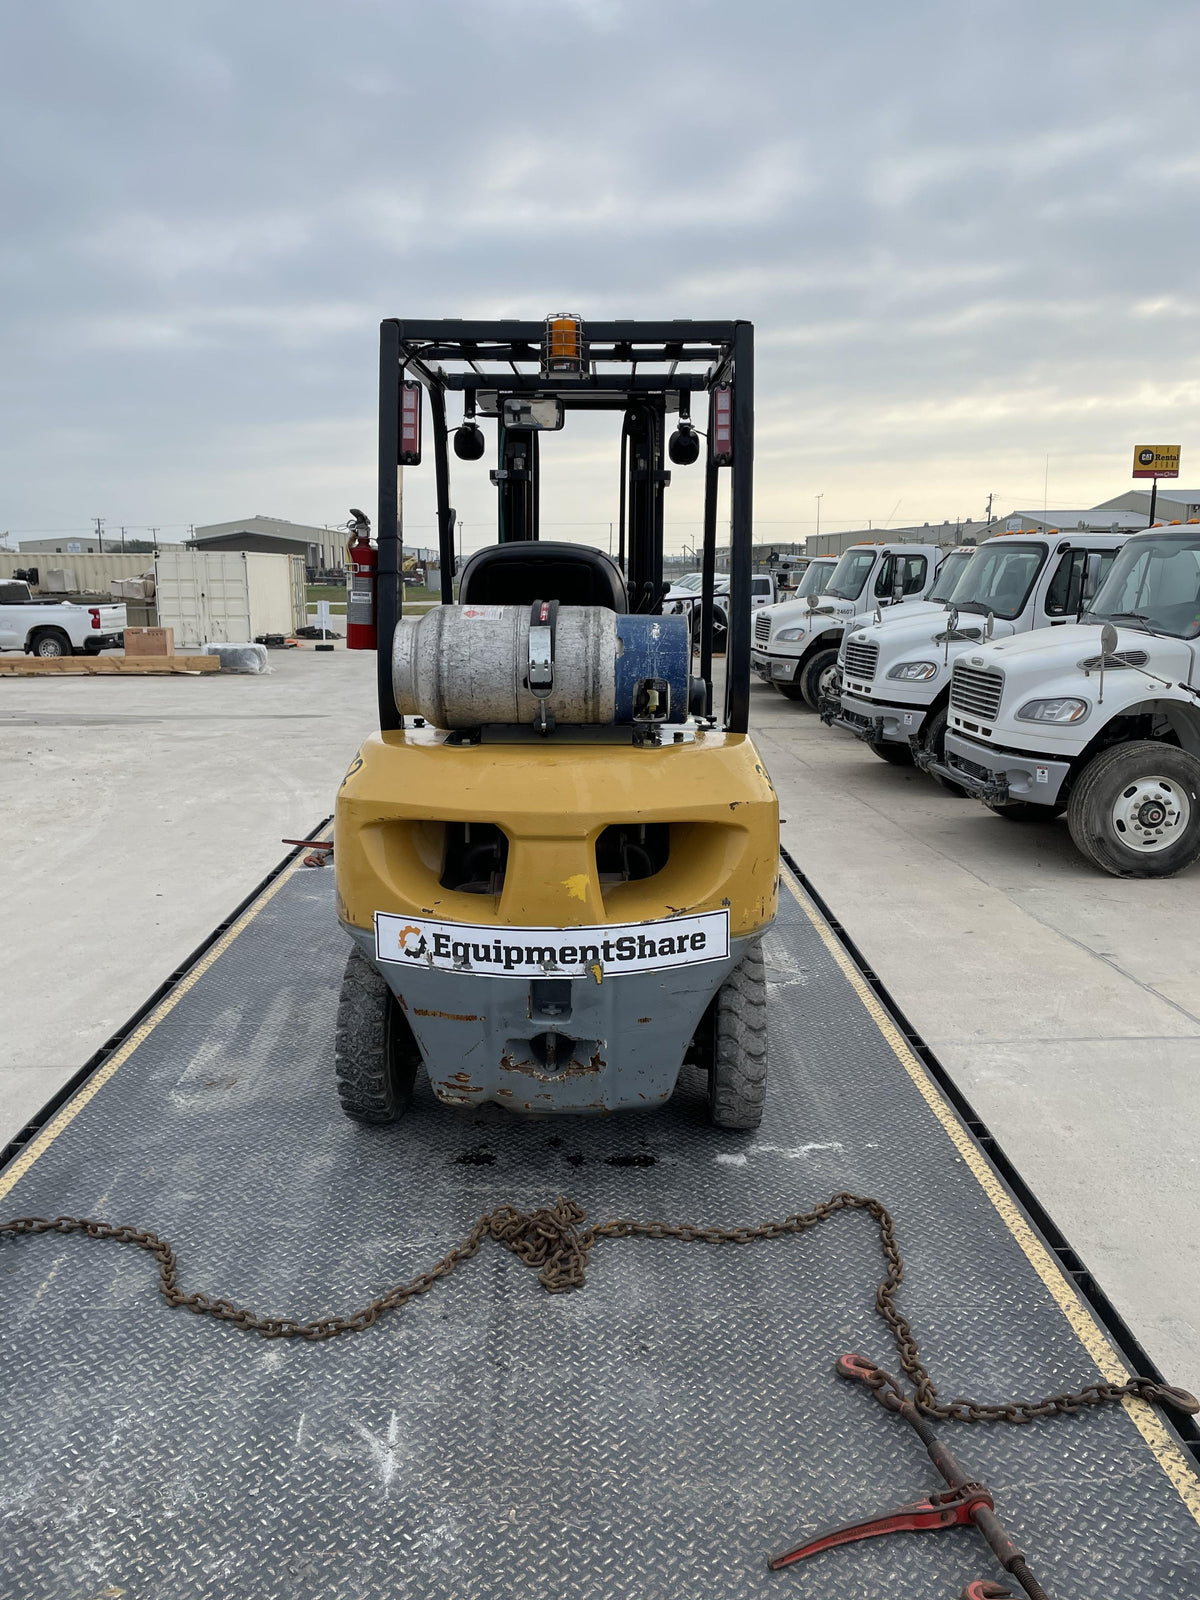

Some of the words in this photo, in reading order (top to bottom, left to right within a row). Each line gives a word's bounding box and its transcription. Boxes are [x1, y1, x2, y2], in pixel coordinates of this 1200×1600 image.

[1141, 453, 1153, 461] CAT
[1155, 453, 1179, 461] Rental
[432, 931, 706, 970] EquipmentShare
